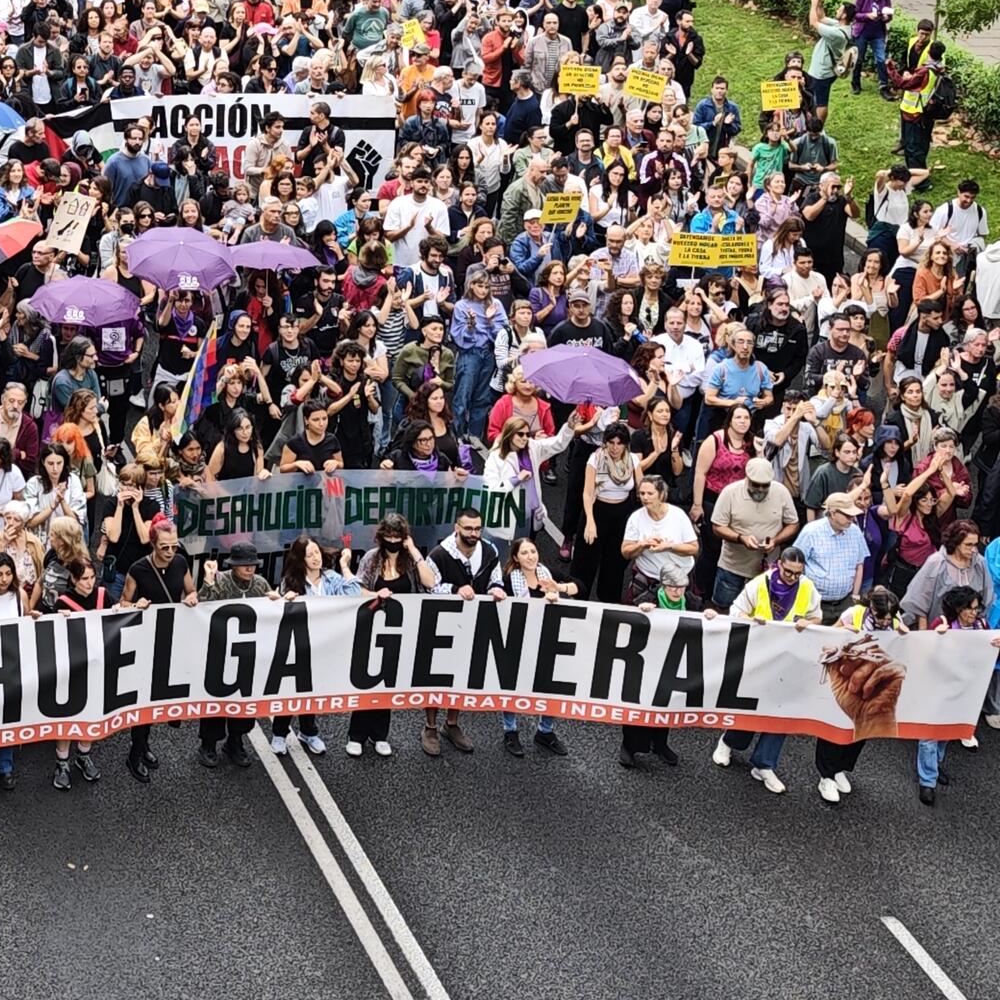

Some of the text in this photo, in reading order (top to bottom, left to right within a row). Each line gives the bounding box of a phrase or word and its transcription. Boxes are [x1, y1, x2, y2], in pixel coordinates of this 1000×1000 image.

[150, 97, 272, 139] ACCIÓN
[324, 477, 344, 497] NI
[349, 599, 760, 711] GENERAL
[152, 702, 258, 720] FONDOS
[268, 695, 360, 714] BUITRE
[390, 692, 548, 712] CONTRATOS
[560, 703, 737, 726] INDEFINIDOS
